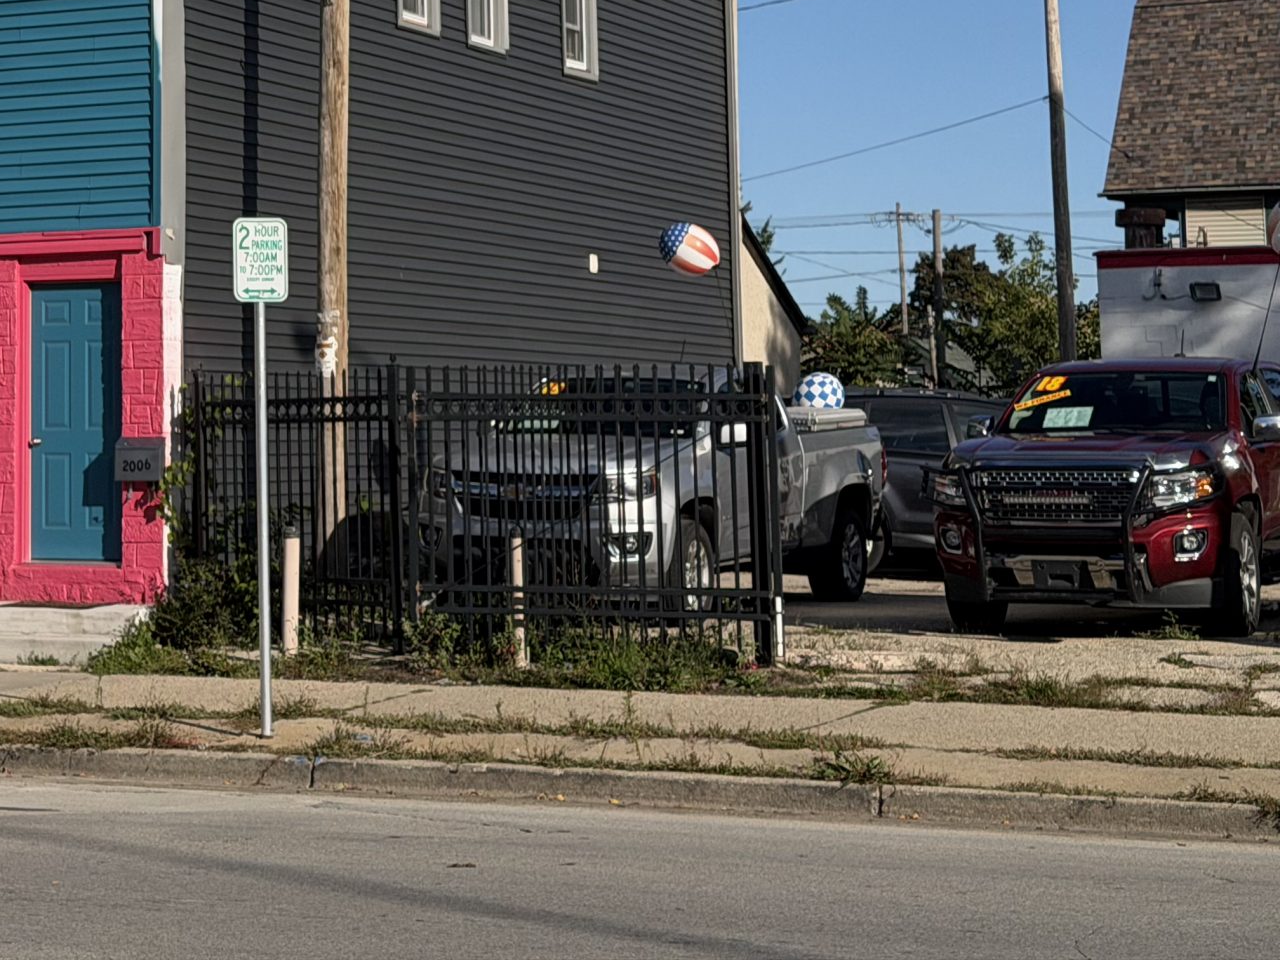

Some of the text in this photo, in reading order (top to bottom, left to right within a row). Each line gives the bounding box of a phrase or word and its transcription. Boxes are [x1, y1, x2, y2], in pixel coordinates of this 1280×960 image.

[239, 224, 279, 250] 2 HOUR
[252, 240, 283, 251] PARKING
[244, 252, 278, 263] 7:00AM
[249, 264, 283, 276] 7:00PM
[1035, 376, 1067, 391] 18
[122, 458, 151, 473] 2006
